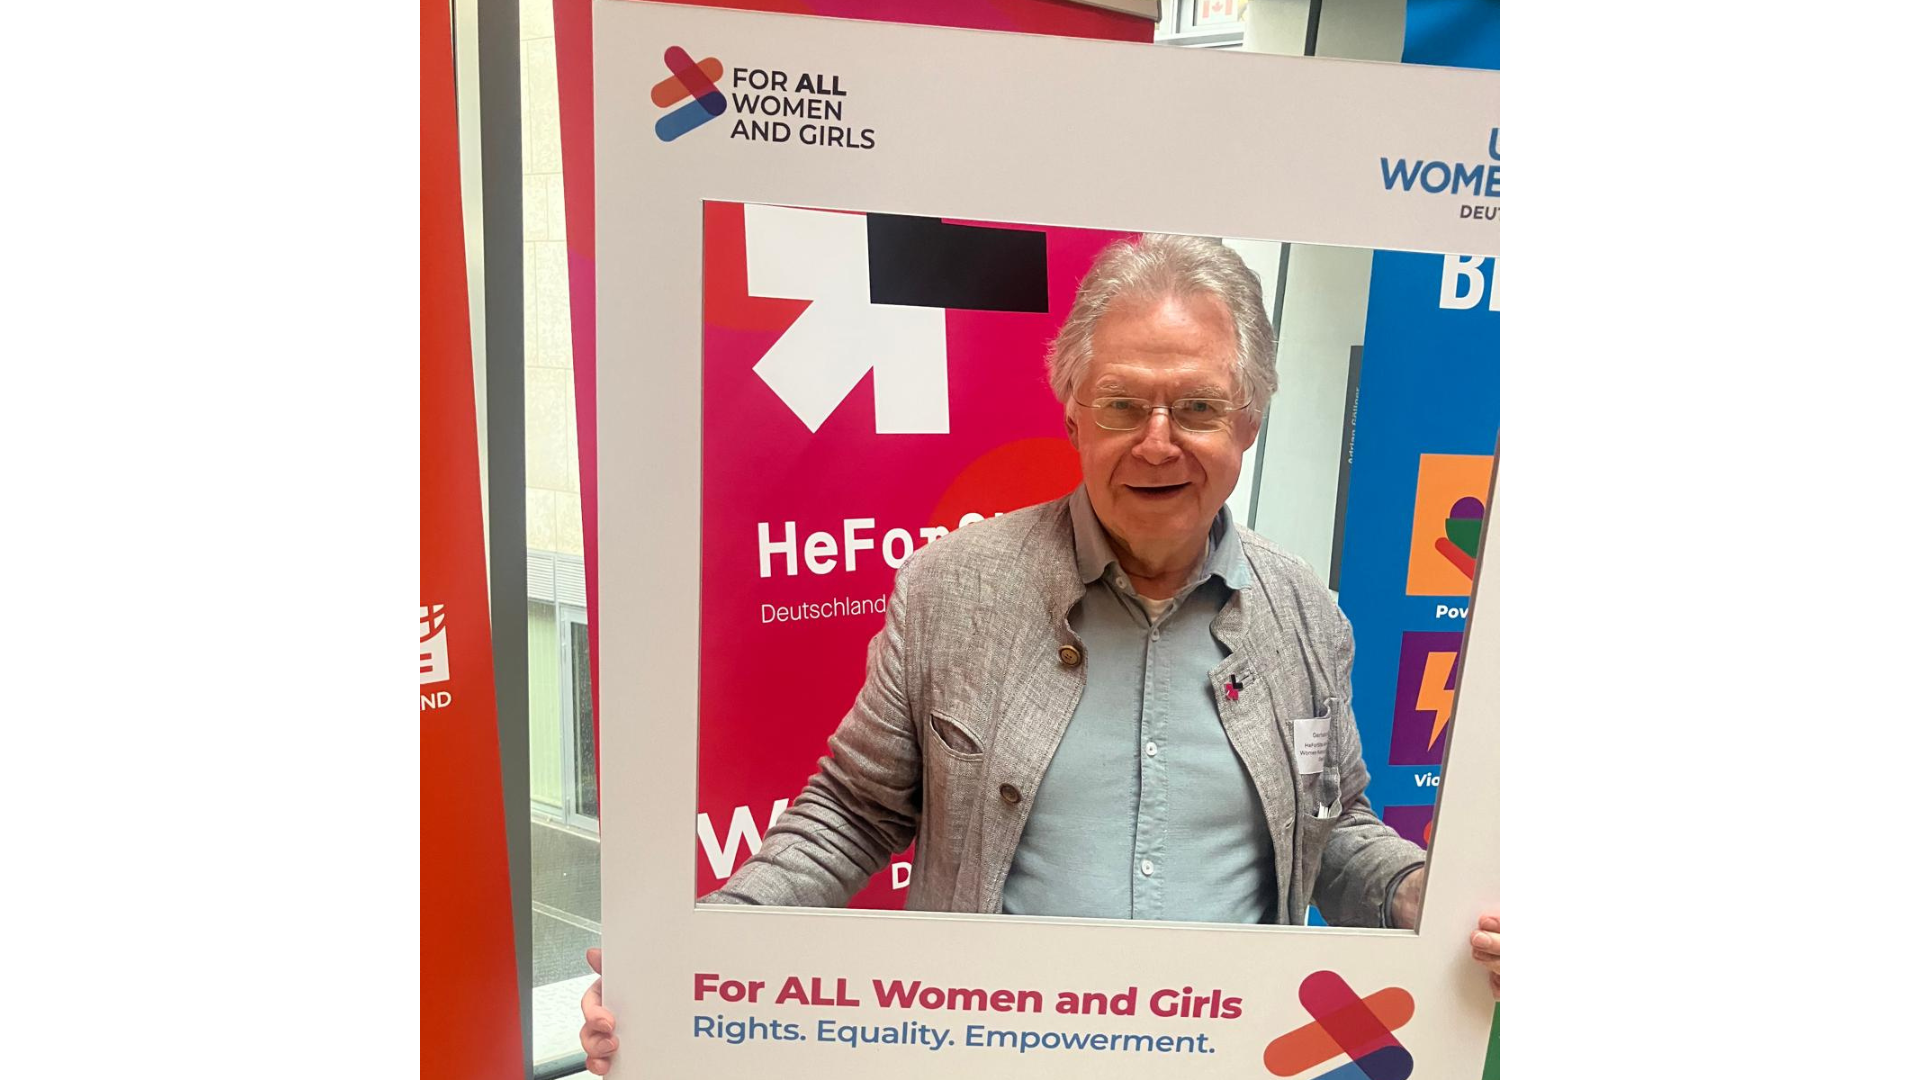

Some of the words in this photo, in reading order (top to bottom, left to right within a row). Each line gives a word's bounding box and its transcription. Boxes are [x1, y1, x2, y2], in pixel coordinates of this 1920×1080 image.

[733, 67, 788, 92] FOR
[794, 73, 847, 97] ALL
[731, 92, 843, 121] WOMEN
[730, 119, 791, 143] AND
[799, 124, 876, 150] GIRLS
[1460, 204, 1500, 221] DEU
[761, 594, 886, 624] Deutschland
[694, 973, 766, 1003] For
[775, 976, 860, 1007] ALL
[872, 979, 1043, 1013] Women
[1055, 986, 1138, 1016] and
[1149, 986, 1243, 1020] Girls
[693, 1014, 807, 1045] Rights.
[817, 1019, 955, 1051] Equality.
[965, 1024, 1216, 1054] Empowerment.
